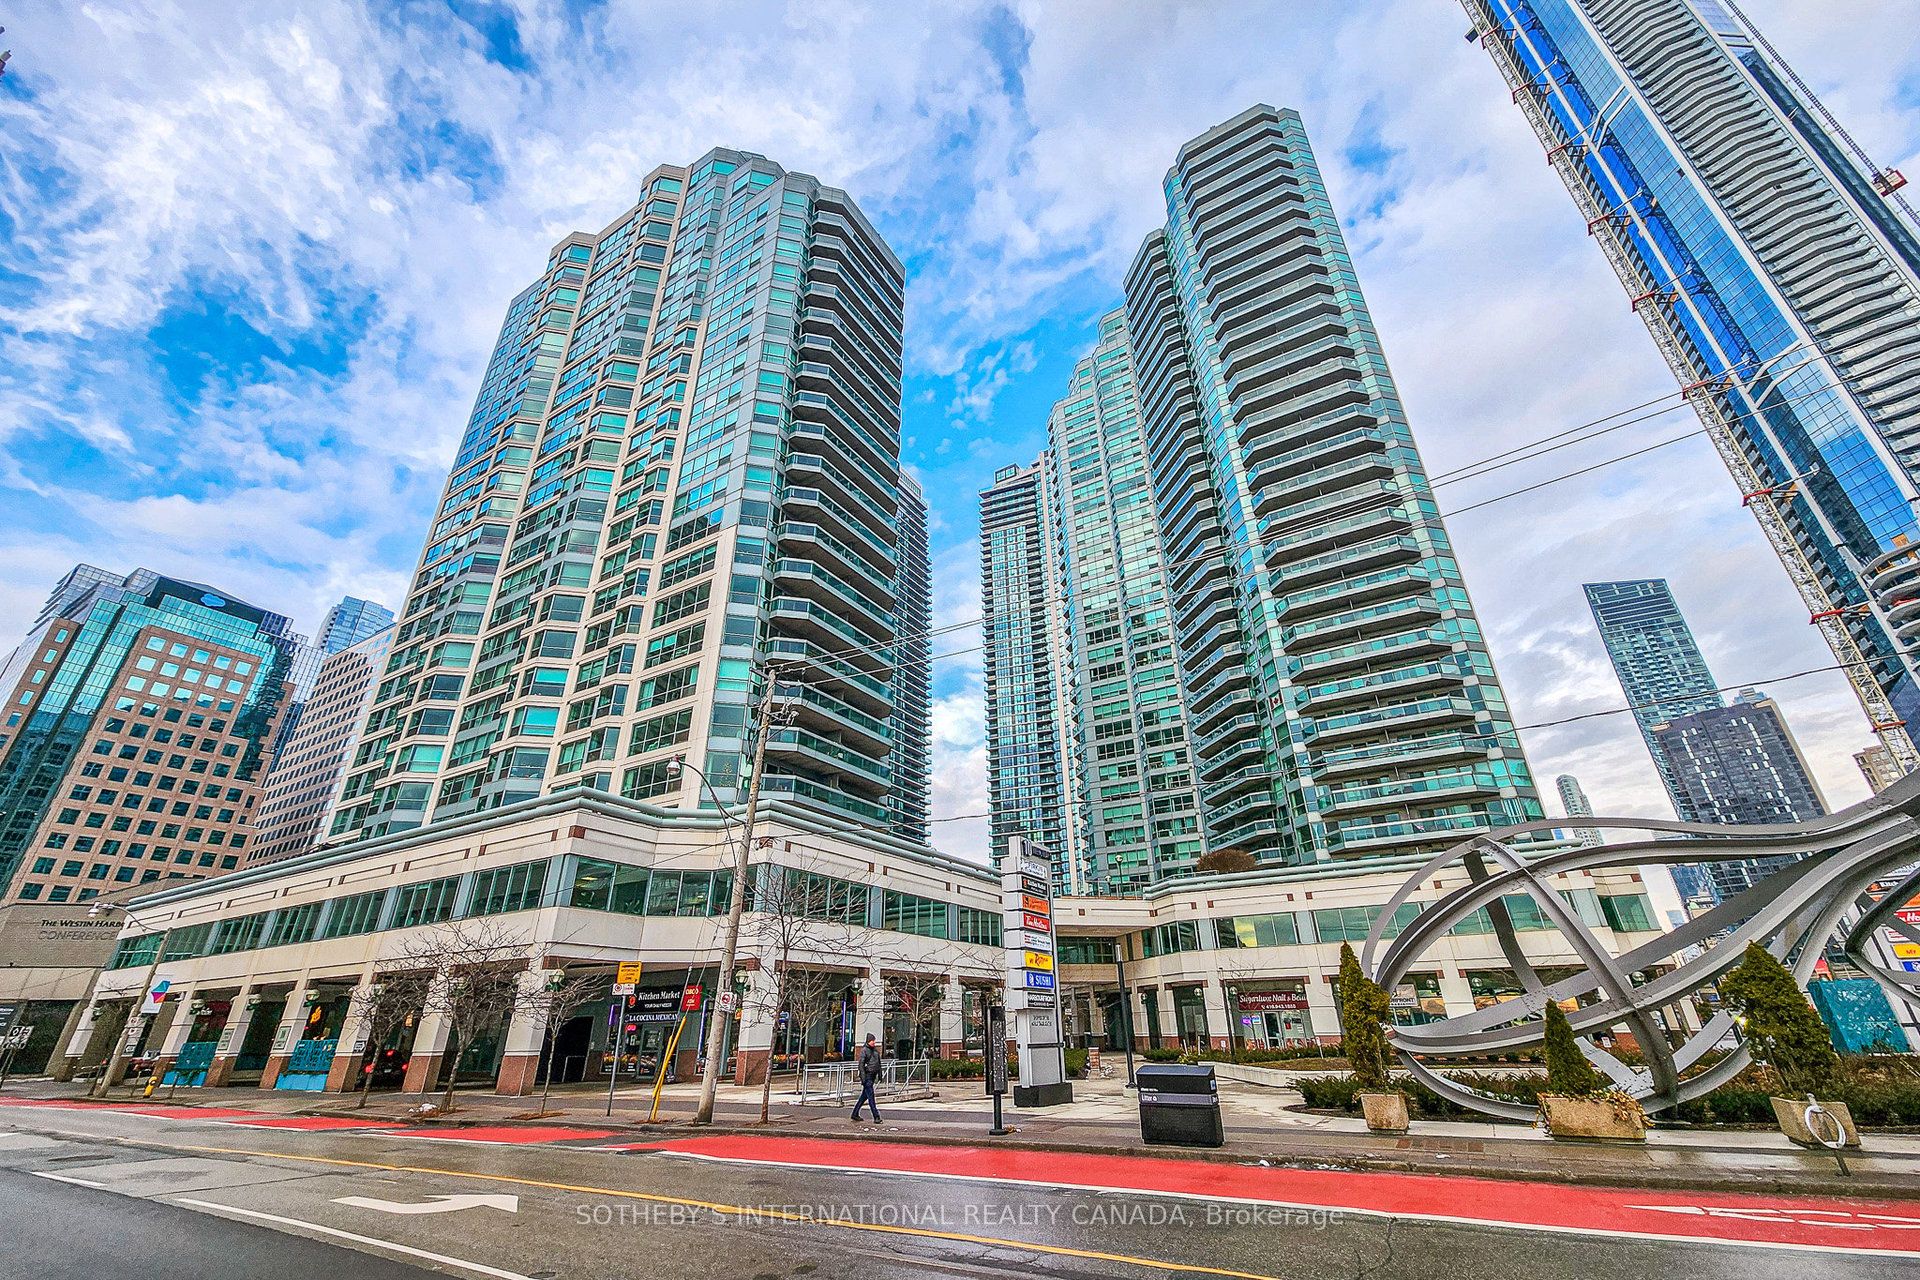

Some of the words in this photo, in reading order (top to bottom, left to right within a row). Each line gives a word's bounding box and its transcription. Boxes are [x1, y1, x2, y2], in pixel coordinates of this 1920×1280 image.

[41, 919, 59, 927] THE
[59, 920, 93, 928] WESTIN
[638, 991, 660, 1001] Kitchen
[660, 990, 680, 999] Market
[1272, 993, 1286, 1002] Nail
